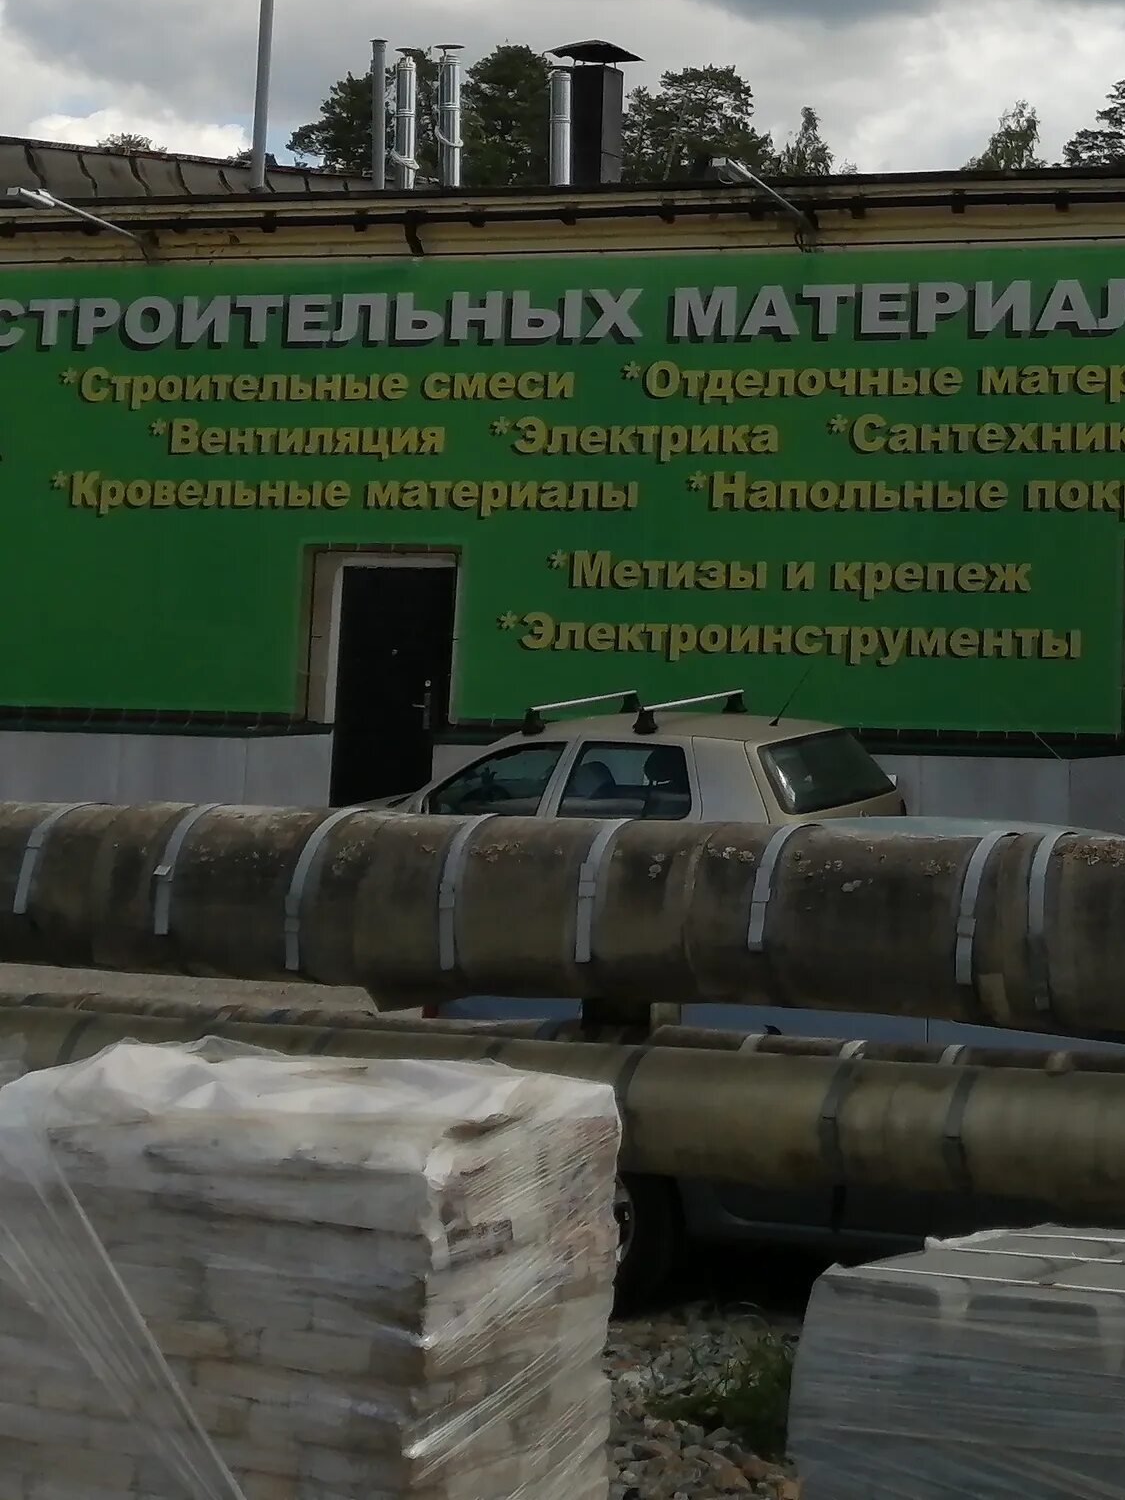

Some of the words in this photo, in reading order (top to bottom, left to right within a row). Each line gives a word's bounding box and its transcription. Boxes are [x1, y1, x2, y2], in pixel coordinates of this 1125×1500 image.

[424, 370, 576, 400] смеси
[365, 477, 640, 518] материалы
[785, 562, 815, 590] и
[832, 559, 1033, 601] крепеж
